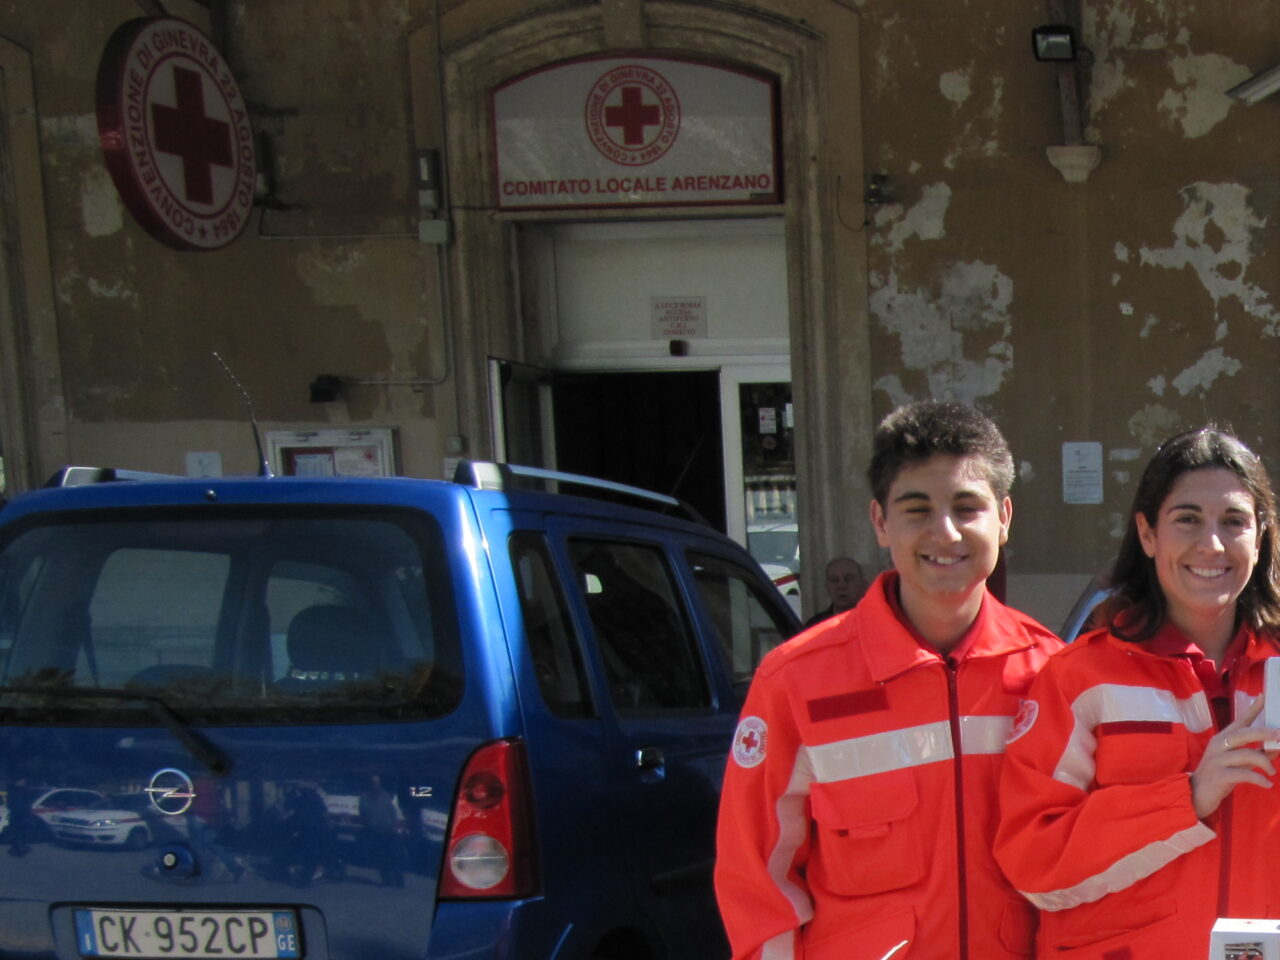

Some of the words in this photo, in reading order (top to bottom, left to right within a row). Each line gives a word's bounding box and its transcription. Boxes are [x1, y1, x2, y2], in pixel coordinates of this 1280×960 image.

[137, 47, 154, 69] DI
[152, 29, 218, 74] GINEVRA
[220, 73, 236, 98] 22
[127, 69, 194, 235] CONVENZIONE
[234, 109, 253, 208] AGOSTO
[503, 179, 591, 196] COMITATO
[596, 177, 667, 194] LOCALE
[671, 174, 771, 192] ARENZANO
[213, 210, 240, 239] 1864
[99, 915, 142, 953] CK
[277, 934, 296, 951] GE
